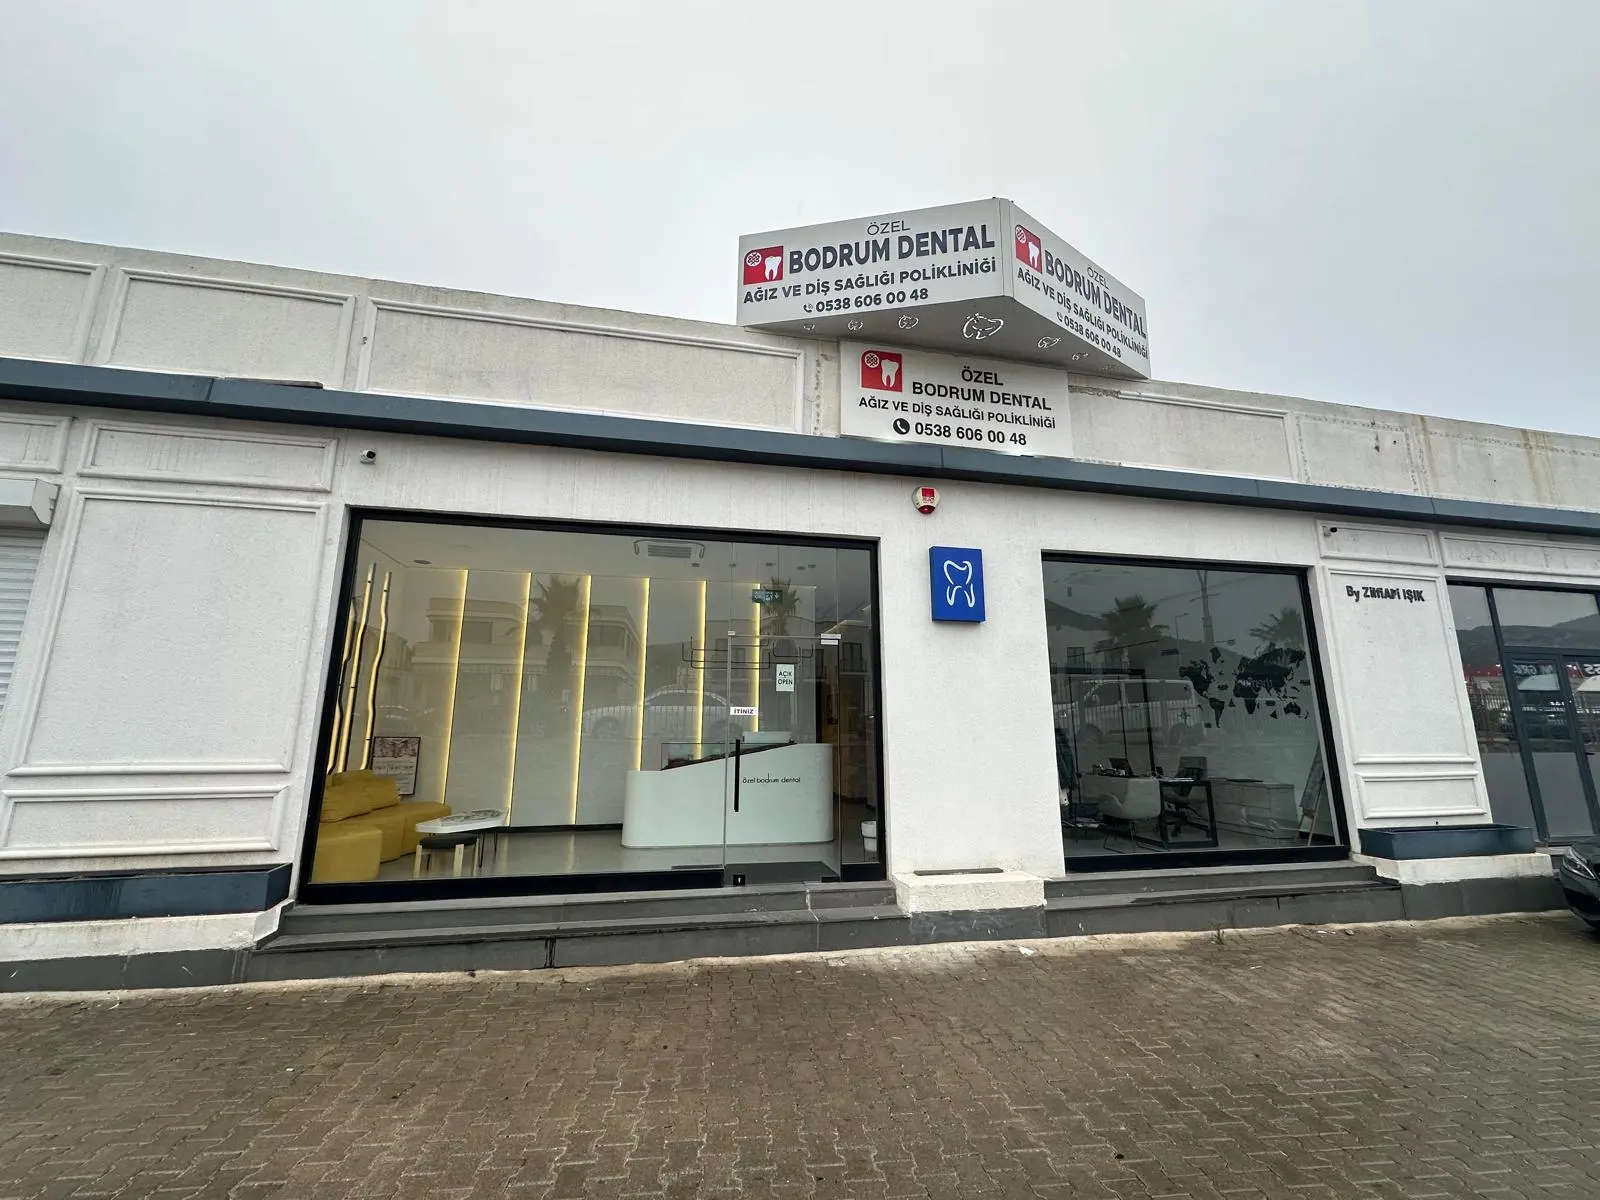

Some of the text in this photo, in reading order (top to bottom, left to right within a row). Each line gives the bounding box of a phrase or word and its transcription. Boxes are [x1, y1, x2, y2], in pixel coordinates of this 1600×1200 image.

[867, 220, 910, 236] ÖZEL
[789, 224, 995, 274] BODRUM DENTAL
[743, 256, 996, 304] AĞIZ VE DİŞ SAĞLIĞI POLİKLİNİĞİ
[1087, 264, 1109, 290] ÖZEL
[815, 288, 928, 313] 0538 606 00 48
[1044, 250, 1147, 339] BODRUM DENTAL
[1017, 267, 1148, 360] AĞIZ VE DİŞ SAĞLIĞI POLİKLİNİĞİ
[1063, 316, 1084, 335] 0538
[1085, 328, 1100, 345] 606
[1101, 337, 1111, 352] 00
[961, 366, 1004, 386] ÖZEL
[912, 382, 1052, 411] BODRUM DENTAL
[858, 396, 1056, 429] AĞIZ VE DİŞ SAĞLIĞI POLİKLİNİĞİ
[915, 422, 1027, 446] 0538 606 00 48
[1346, 585, 1360, 602] By
[1402, 588, 1425, 603] IŞIK
